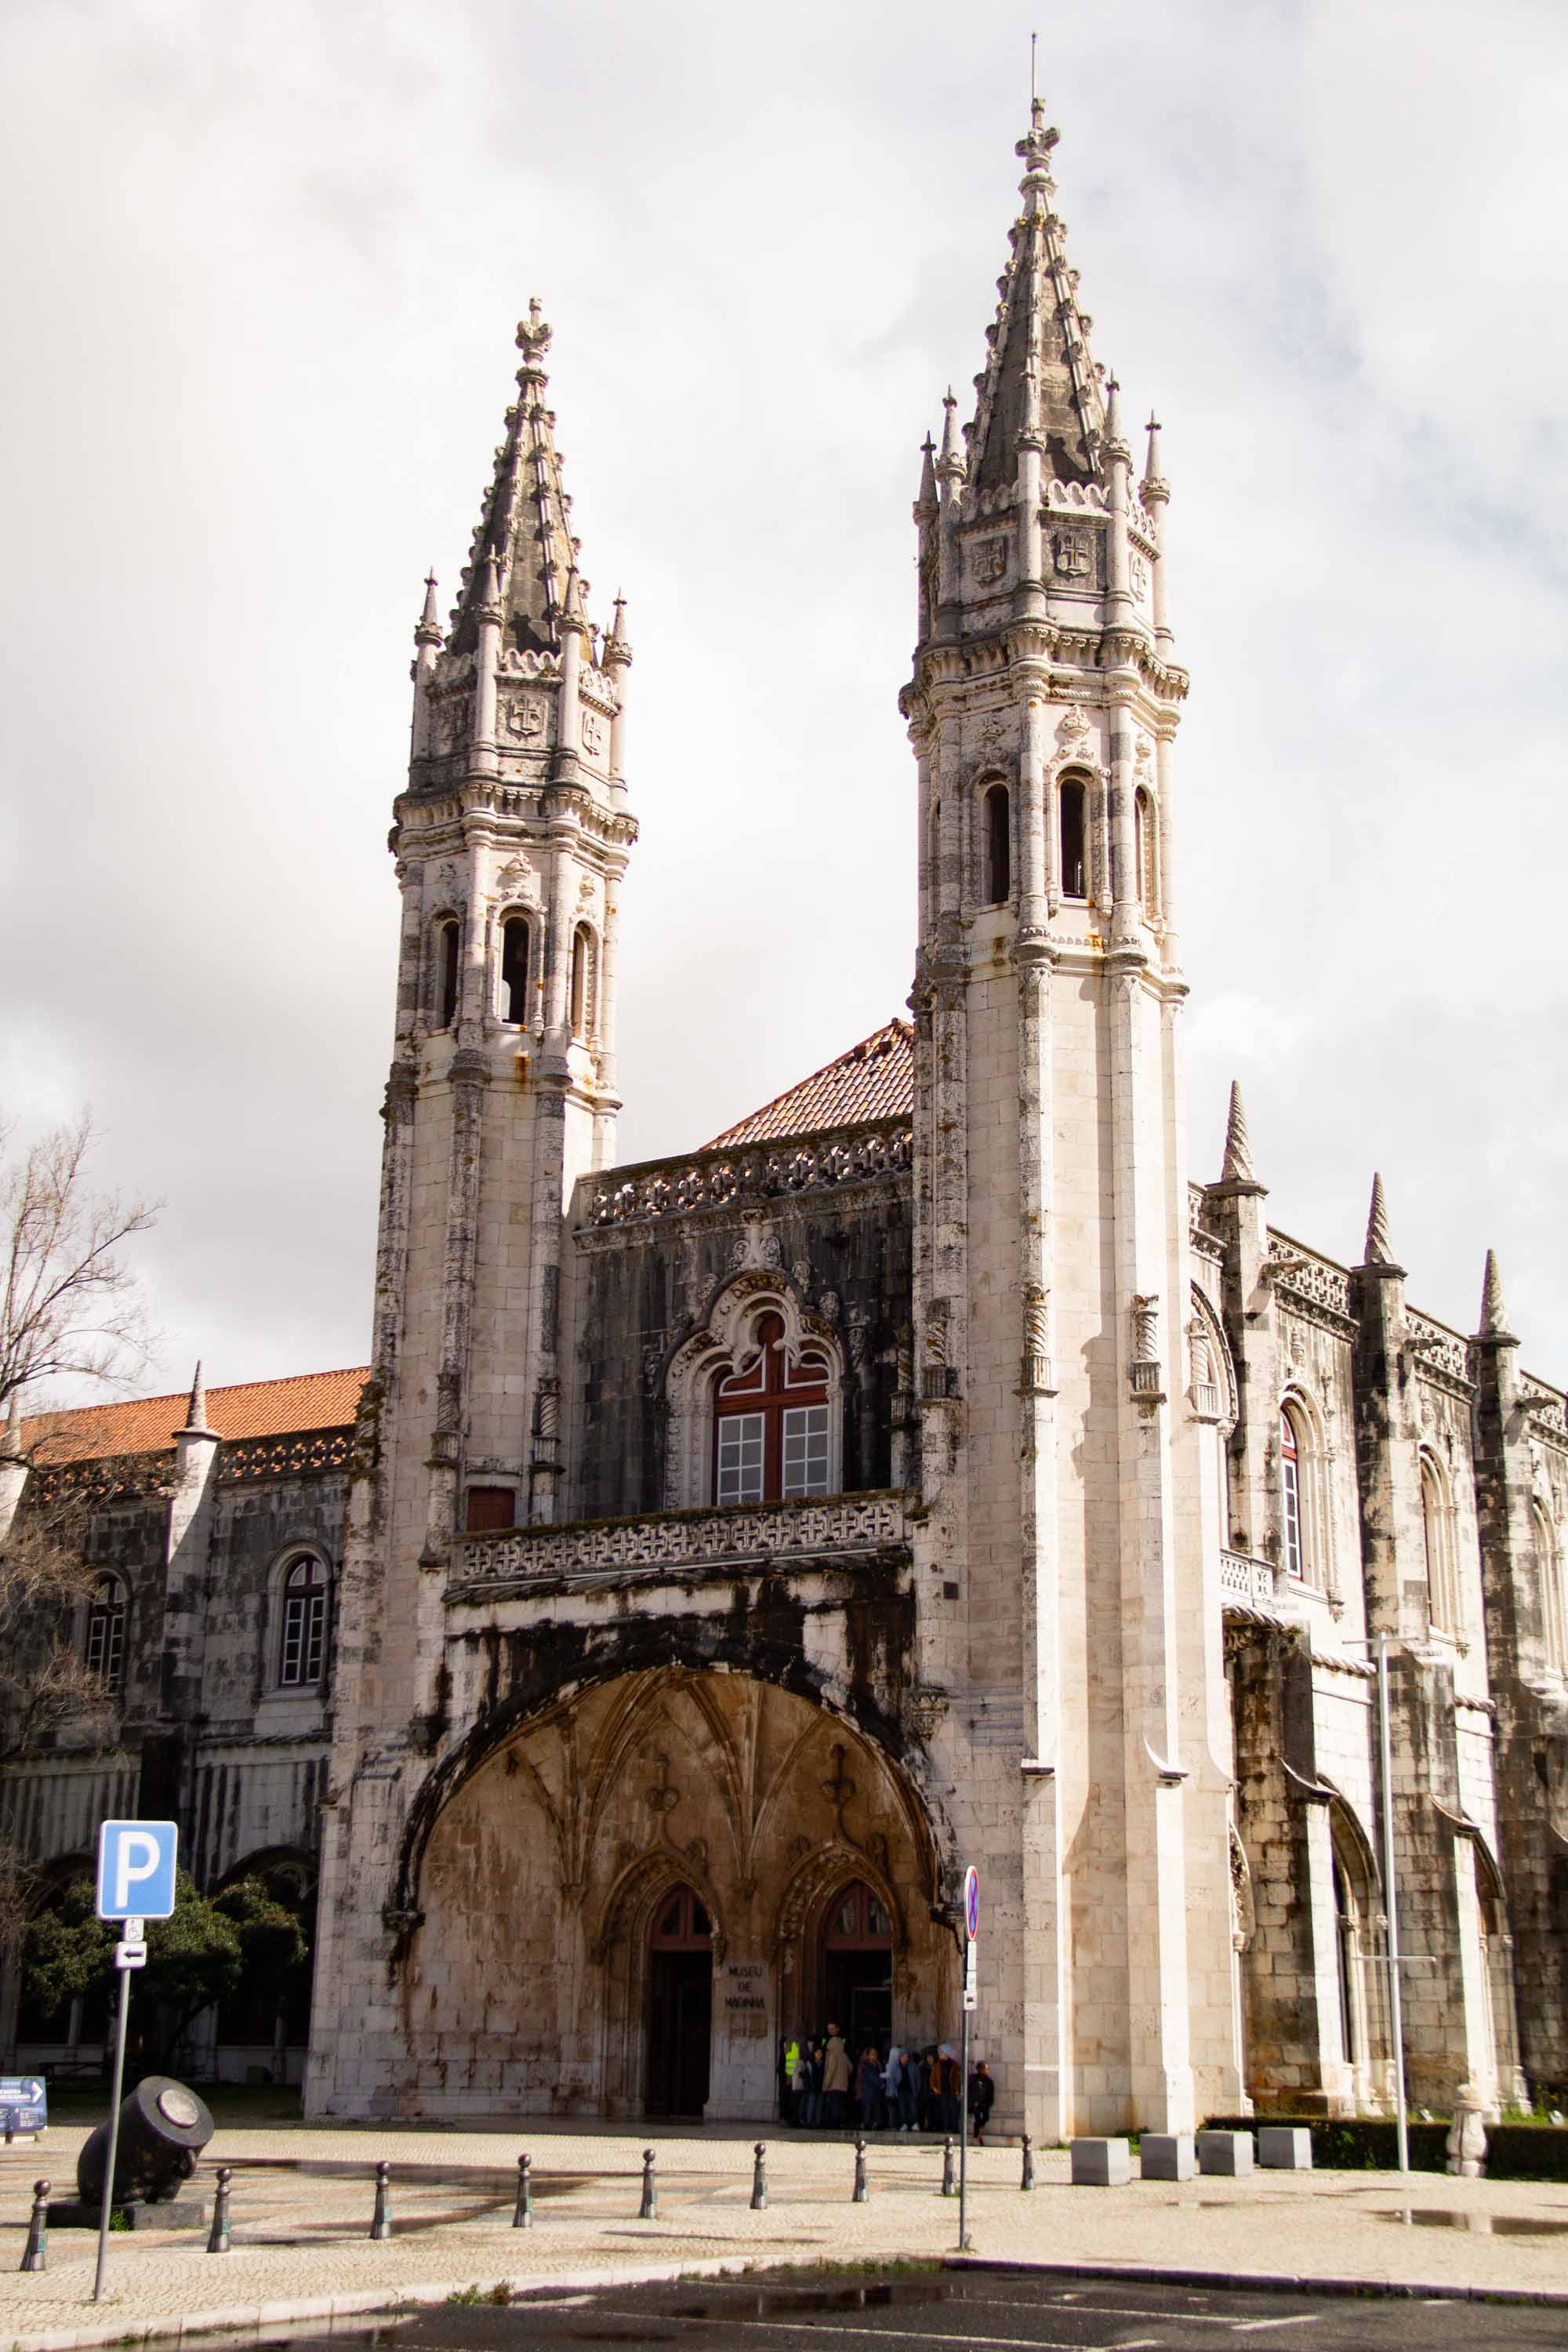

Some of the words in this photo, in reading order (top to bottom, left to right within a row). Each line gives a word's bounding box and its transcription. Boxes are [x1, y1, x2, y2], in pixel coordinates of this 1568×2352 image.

[115, 1831, 160, 1907] P
[728, 1965, 763, 1976] MUSEU
[738, 1980, 752, 1992] DE
